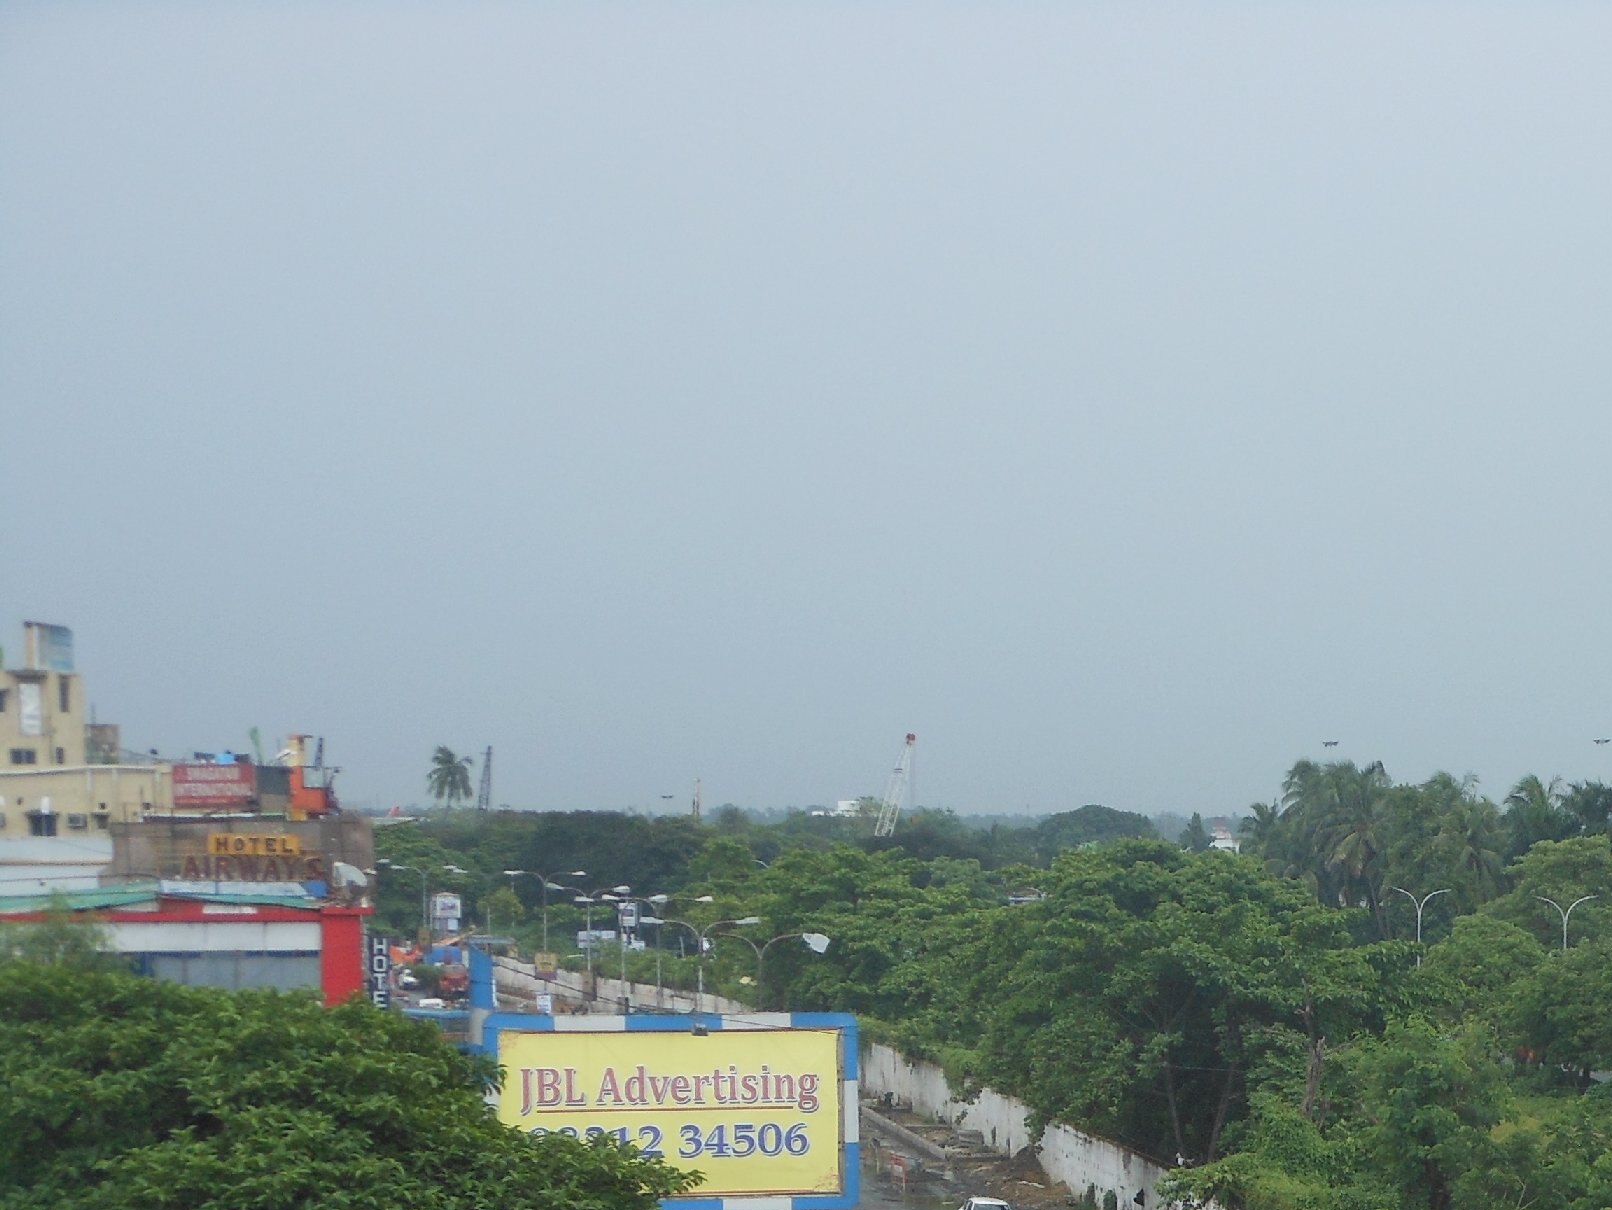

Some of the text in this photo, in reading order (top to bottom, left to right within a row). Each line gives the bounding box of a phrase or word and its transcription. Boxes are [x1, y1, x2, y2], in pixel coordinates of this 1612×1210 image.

[215, 837, 293, 853] HOTEL
[182, 856, 323, 882] AIRWAYS
[520, 1064, 820, 1116] JBL Advertising
[678, 1122, 811, 1159] 34506
